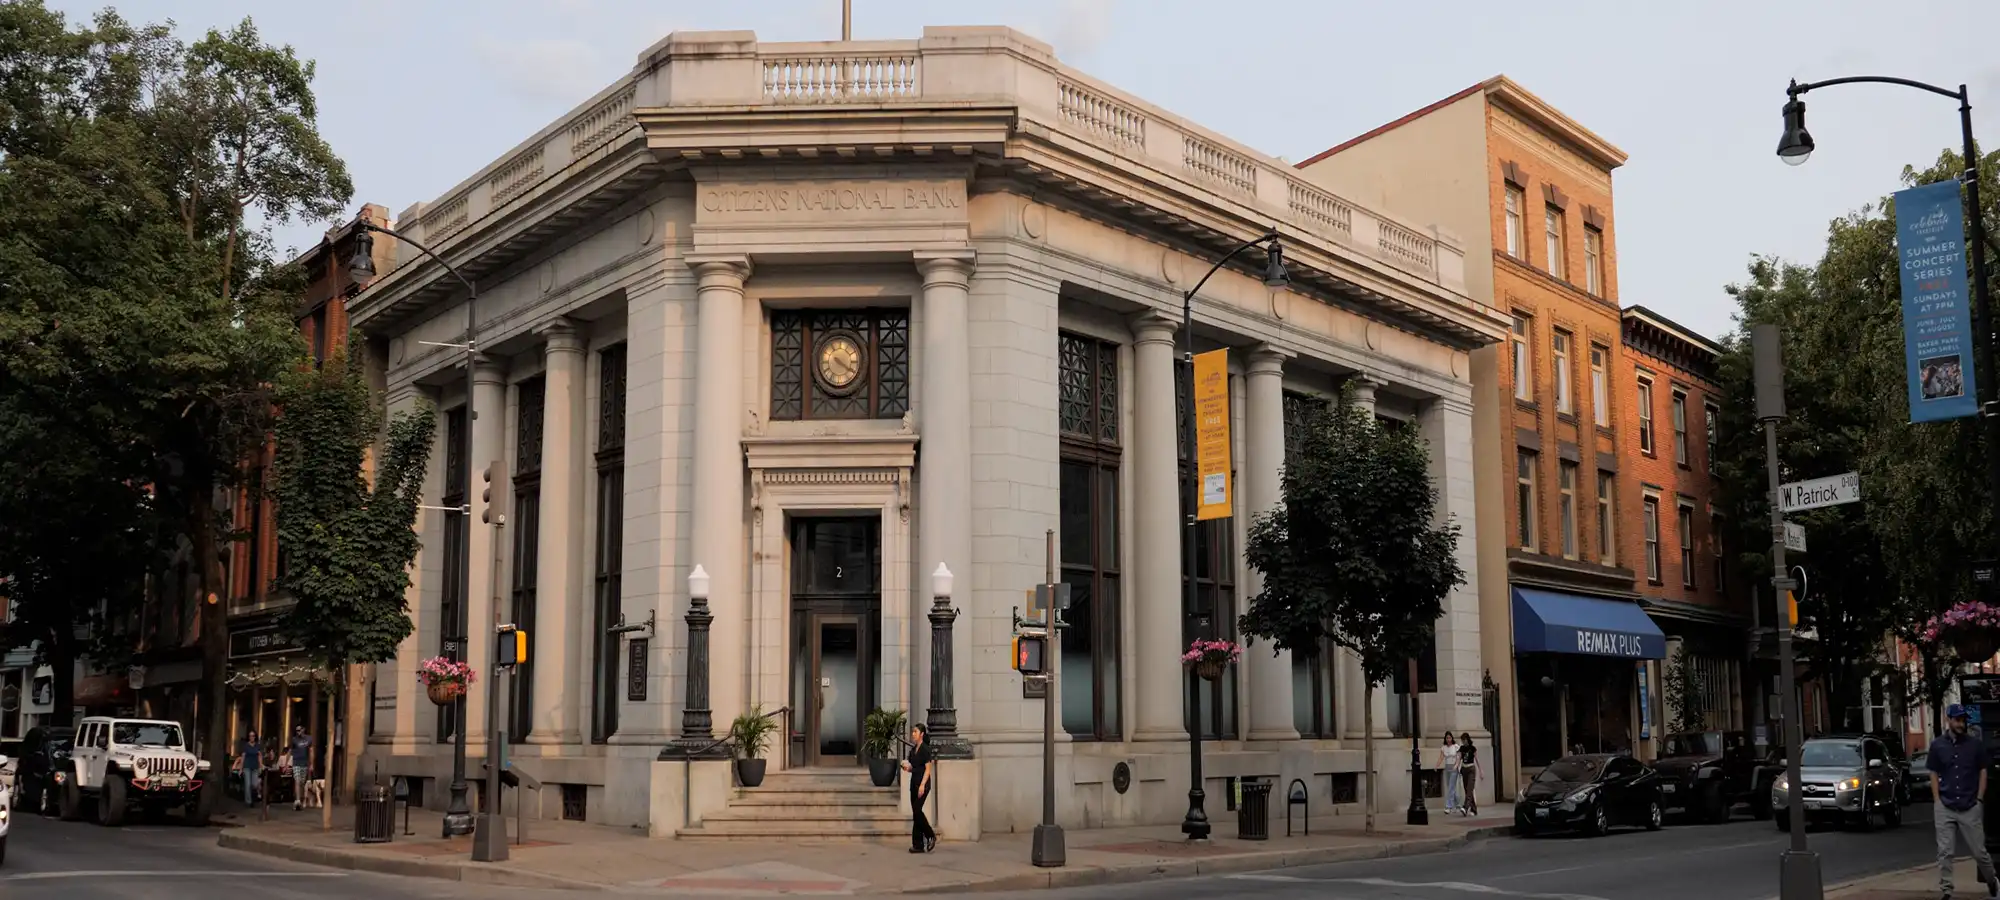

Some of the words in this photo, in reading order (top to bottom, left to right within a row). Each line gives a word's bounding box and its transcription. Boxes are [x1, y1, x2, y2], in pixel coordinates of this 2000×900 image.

[702, 188, 789, 213] CITIZENS
[796, 188, 896, 212] NATIONAL
[902, 186, 960, 210] BANK
[1907, 241, 1956, 258] SUMMER
[1905, 253, 1960, 270] CONCERT
[1913, 267, 1953, 281] SERIES
[1913, 290, 1957, 304] SUNDAYS
[1920, 304, 1932, 313] AT
[1935, 301, 1954, 310] 7PM
[1927, 323, 1955, 335] AUGUST
[1917, 339, 1939, 349] BAKER
[1941, 336, 1960, 345] PARK
[1918, 347, 1937, 356] BAND
[1938, 344, 1960, 353] SHELL
[1841, 475, 1858, 488] 0-100
[1783, 487, 1795, 507] W.
[1797, 484, 1839, 505] Patrick
[1852, 487, 1860, 498] St
[836, 566, 842, 577] 2
[1577, 631, 1617, 654] RE/MAX
[1619, 635, 1641, 655] PLUS
